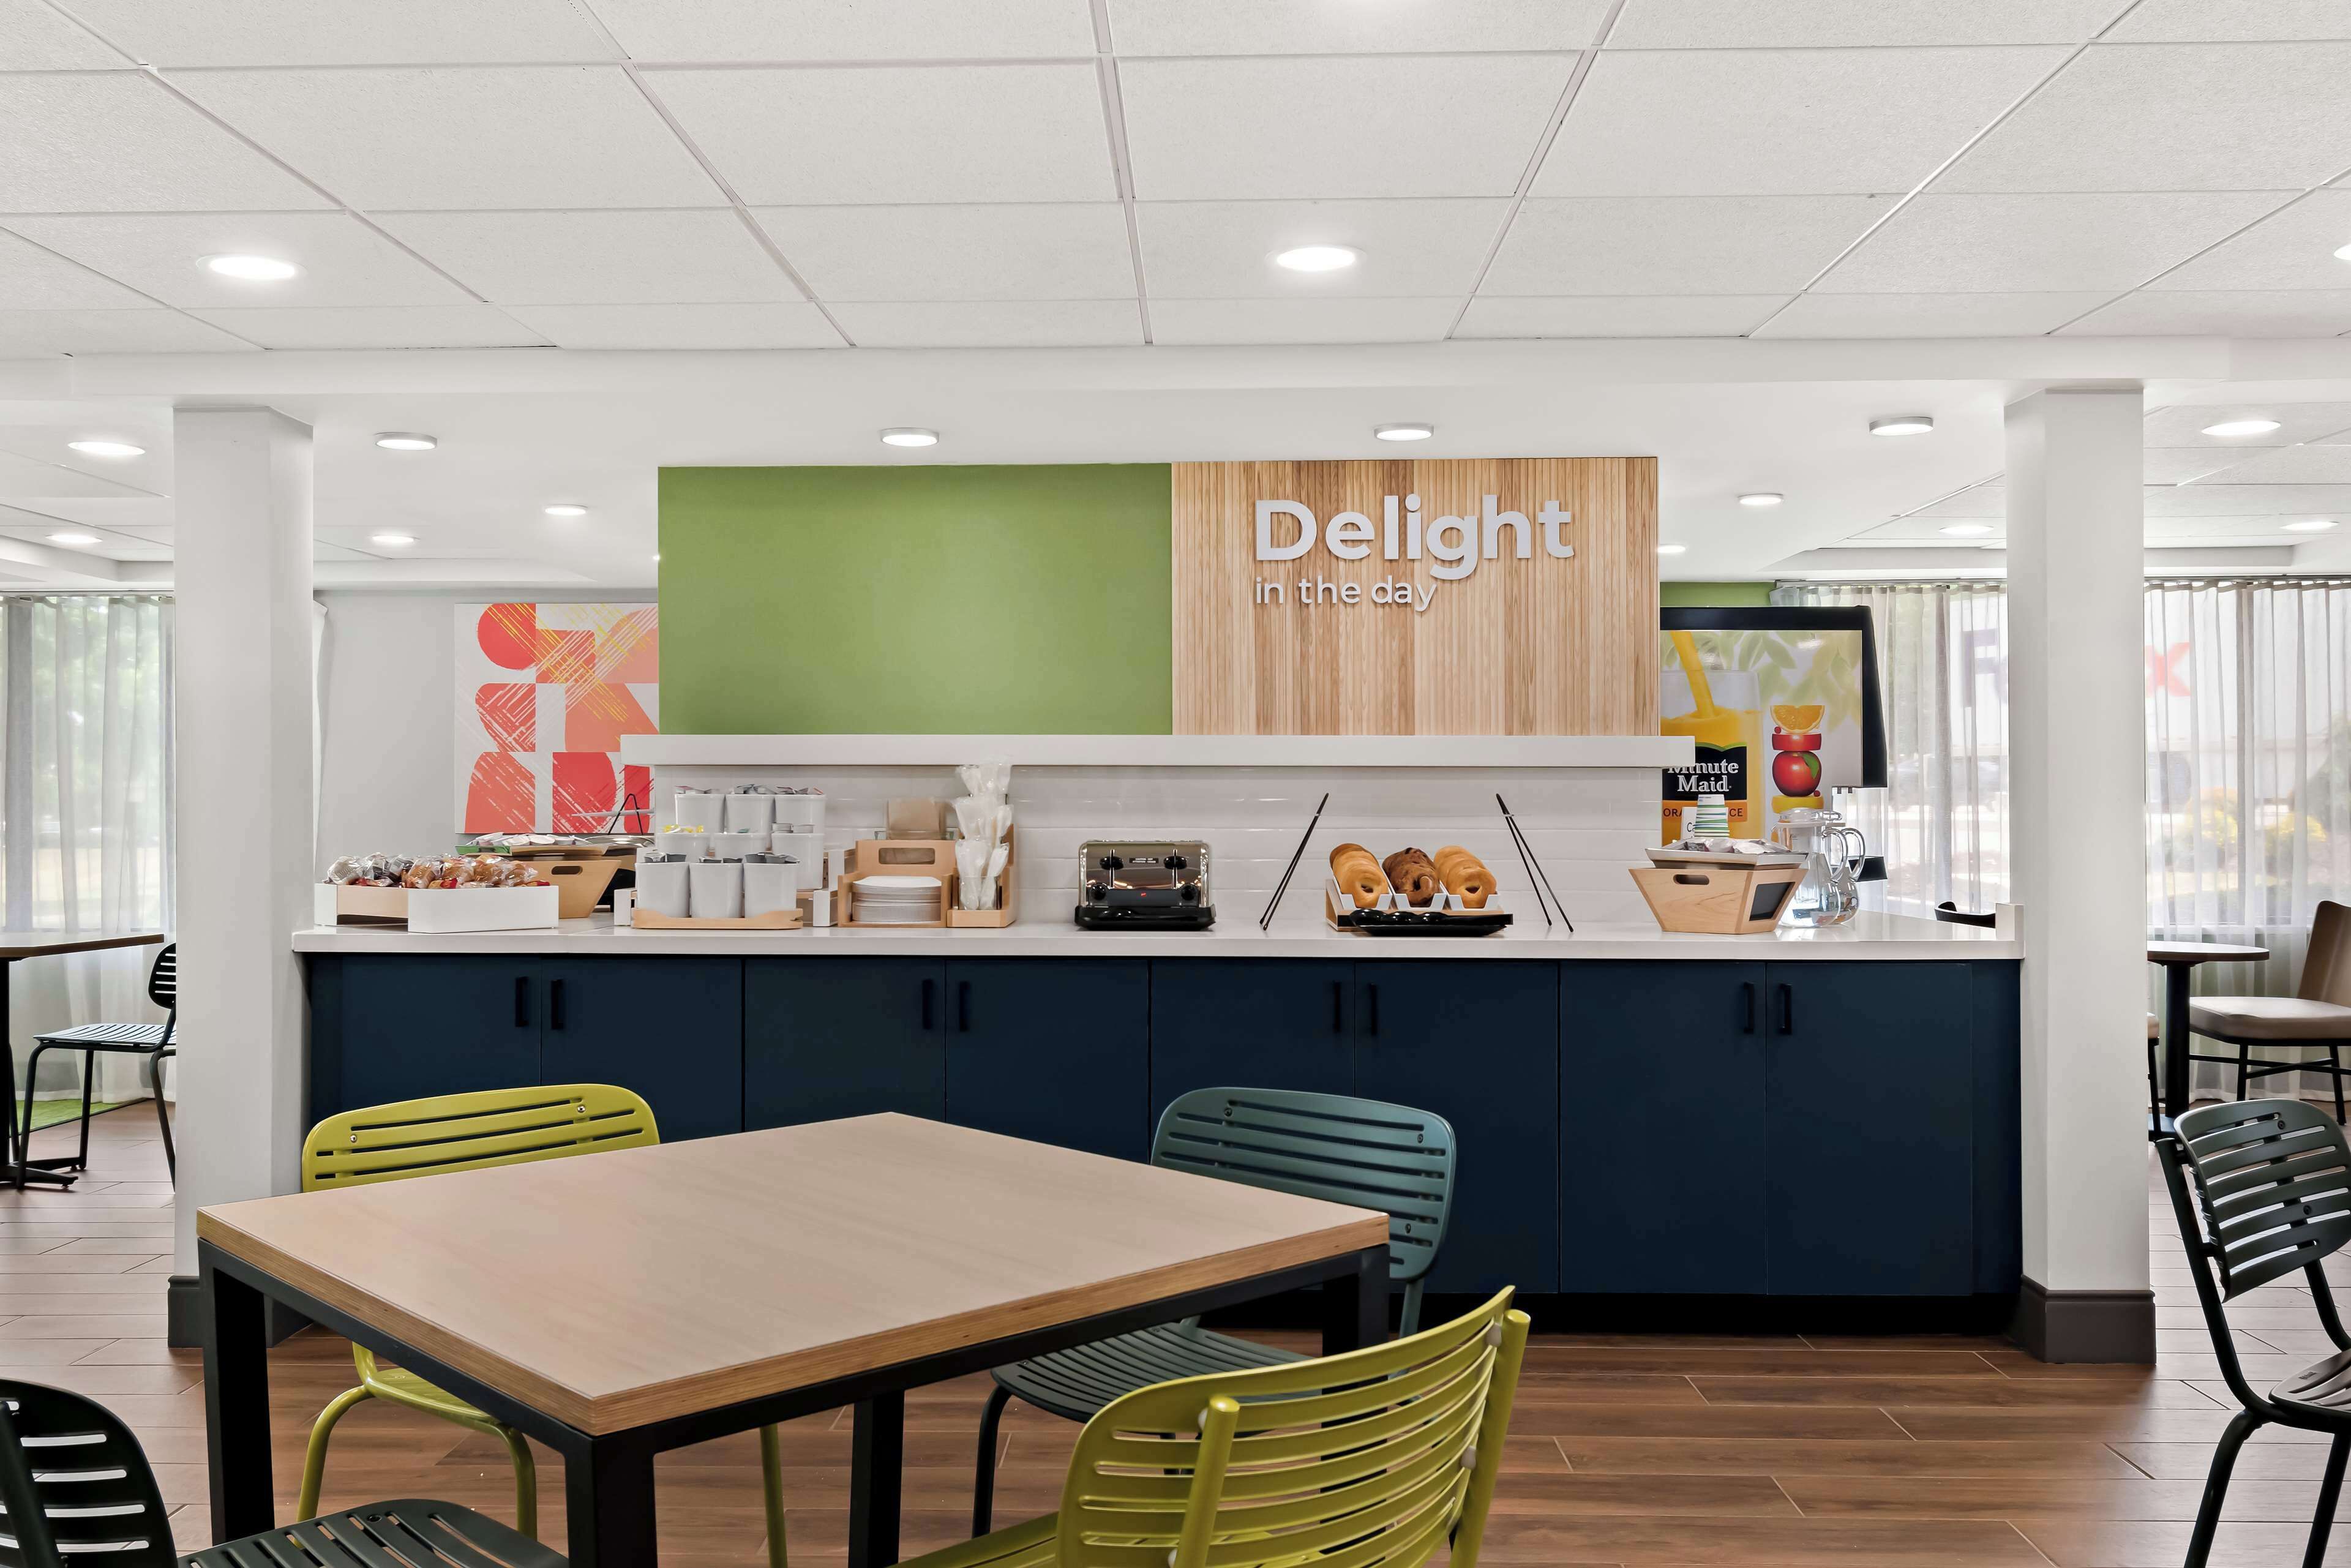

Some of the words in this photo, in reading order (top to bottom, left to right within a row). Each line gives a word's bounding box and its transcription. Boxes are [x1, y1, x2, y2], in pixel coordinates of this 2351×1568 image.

[1256, 493, 1575, 580] Delight
[1256, 577, 1284, 604] in
[1298, 574, 1362, 604] the
[1371, 574, 1438, 612] day
[1677, 775, 1730, 792] Maid
